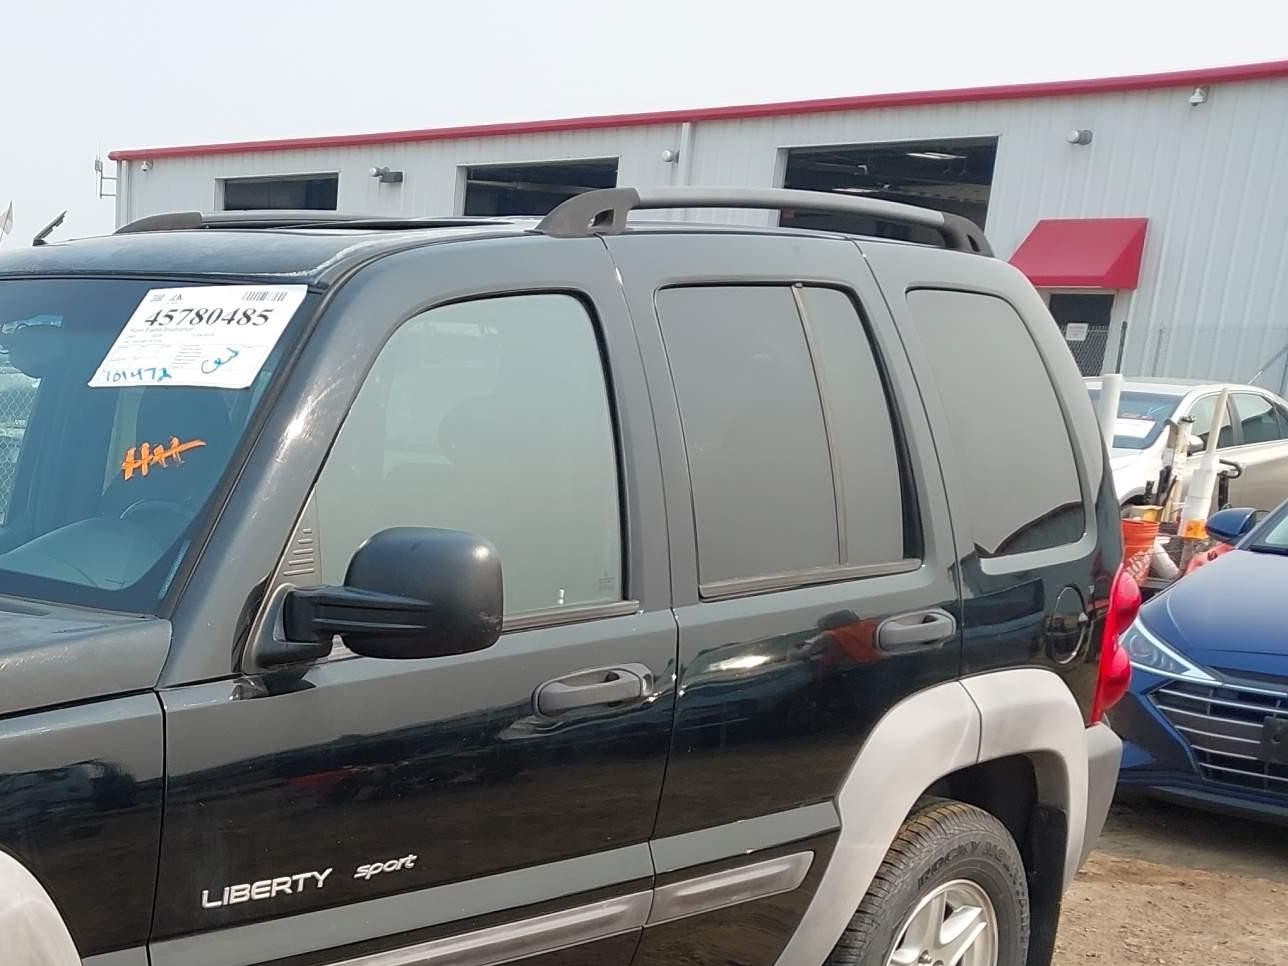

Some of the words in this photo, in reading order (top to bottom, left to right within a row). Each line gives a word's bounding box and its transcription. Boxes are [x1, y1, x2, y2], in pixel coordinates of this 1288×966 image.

[145, 308, 274, 326] 45780485
[201, 867, 333, 909] LIBERTY
[354, 854, 417, 880] sport
